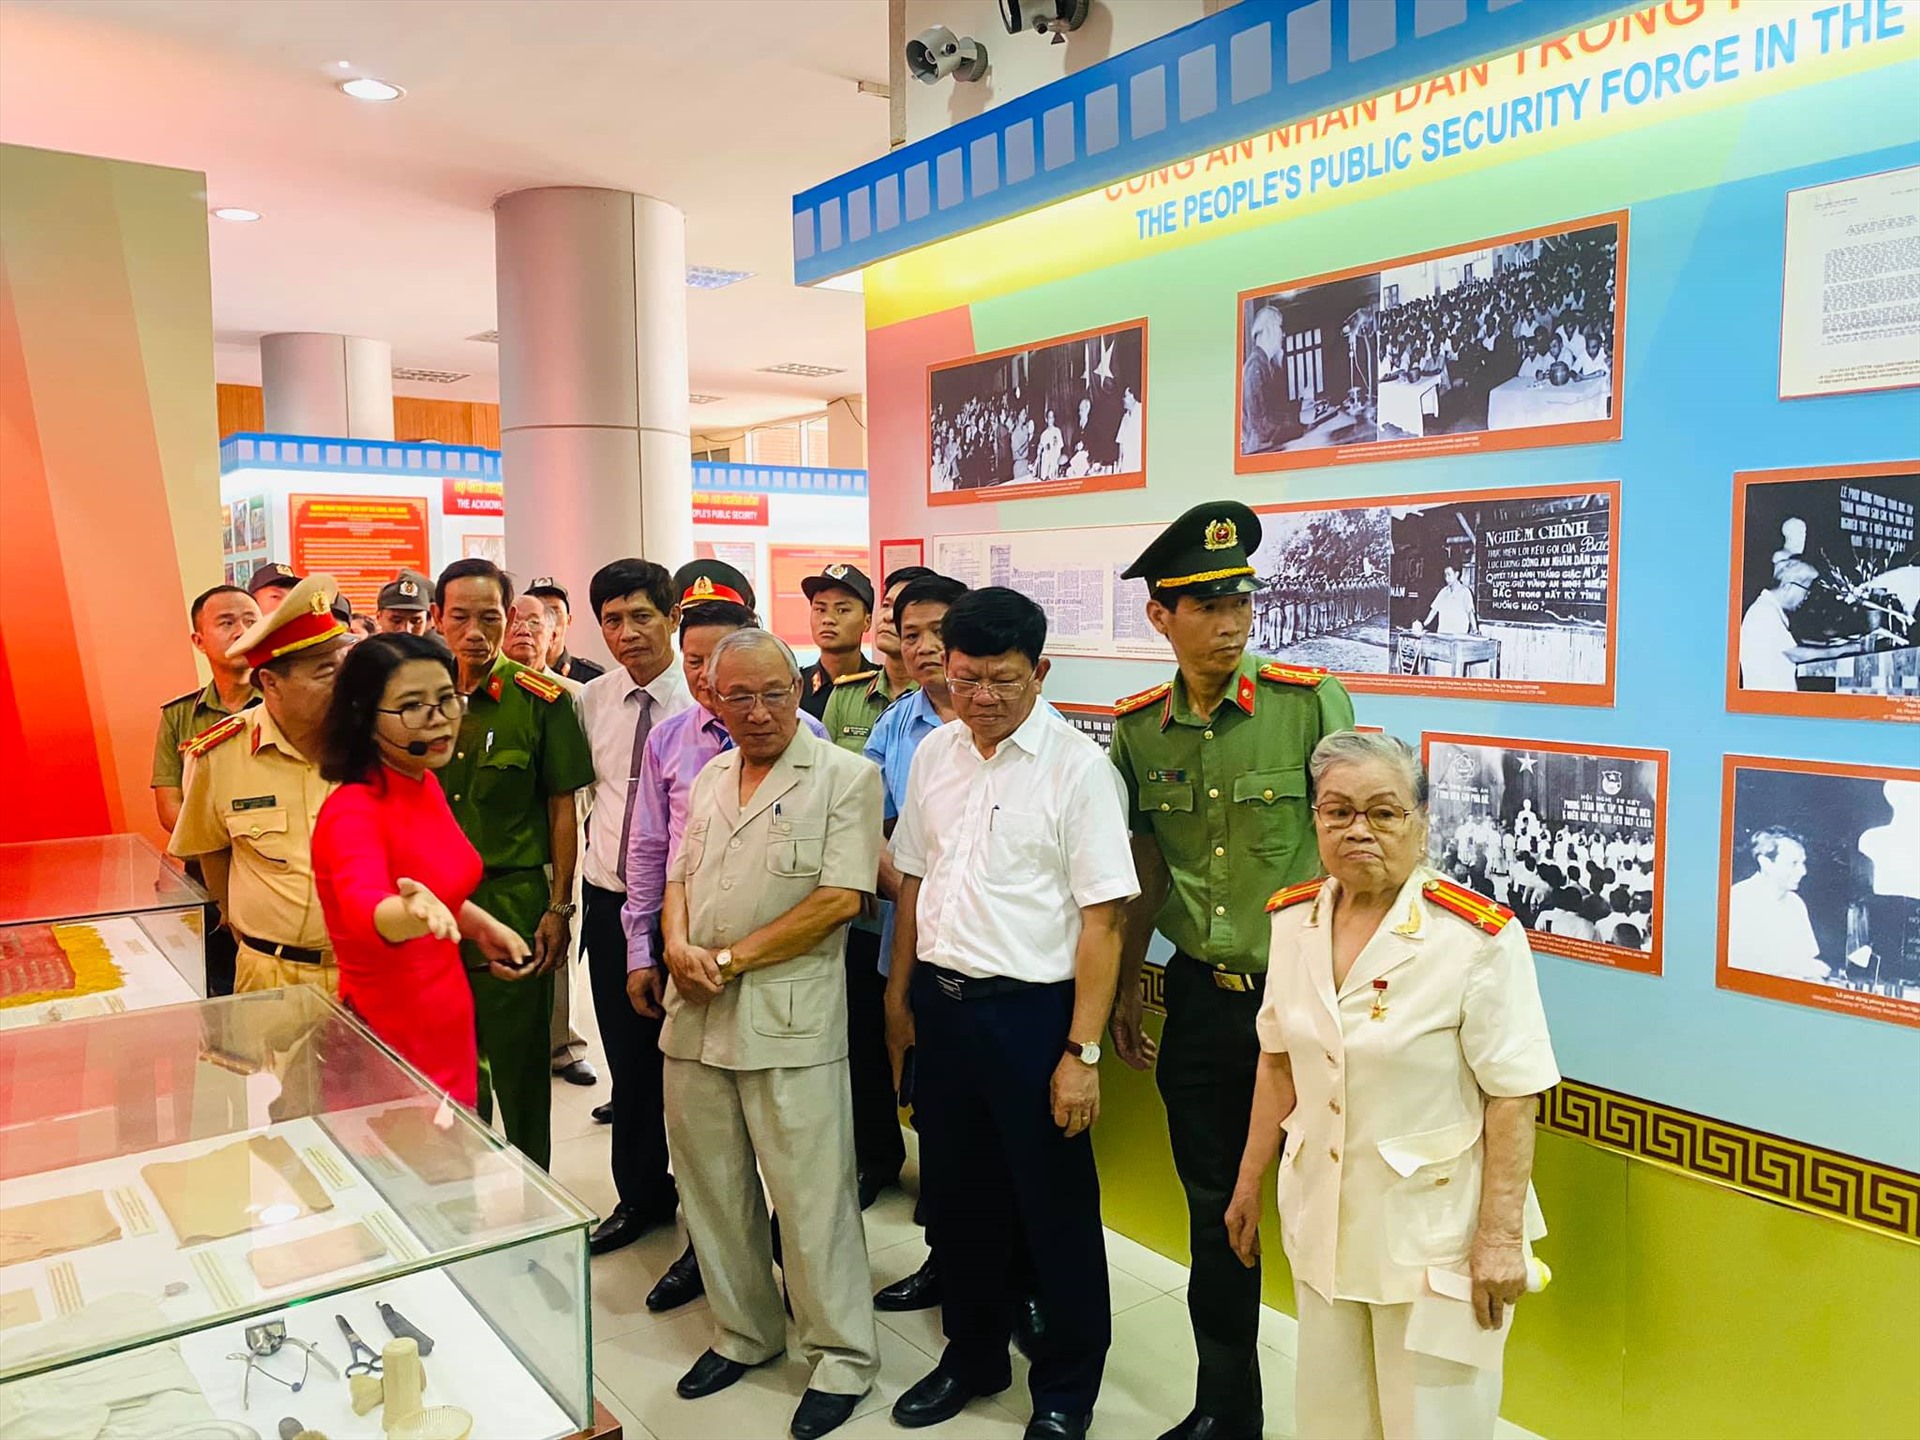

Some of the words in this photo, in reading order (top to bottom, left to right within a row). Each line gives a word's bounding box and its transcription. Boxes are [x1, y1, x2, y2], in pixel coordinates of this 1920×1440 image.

[1136, 201, 1177, 240] THE
[1184, 165, 1302, 228] PEOPLE'S
[1310, 132, 1412, 193] PUBLIC
[1422, 78, 1591, 163] SECURITY
[1601, 34, 1740, 113] FORCE
[1755, 18, 1796, 72] IN
[1812, 0, 1905, 54] THE
